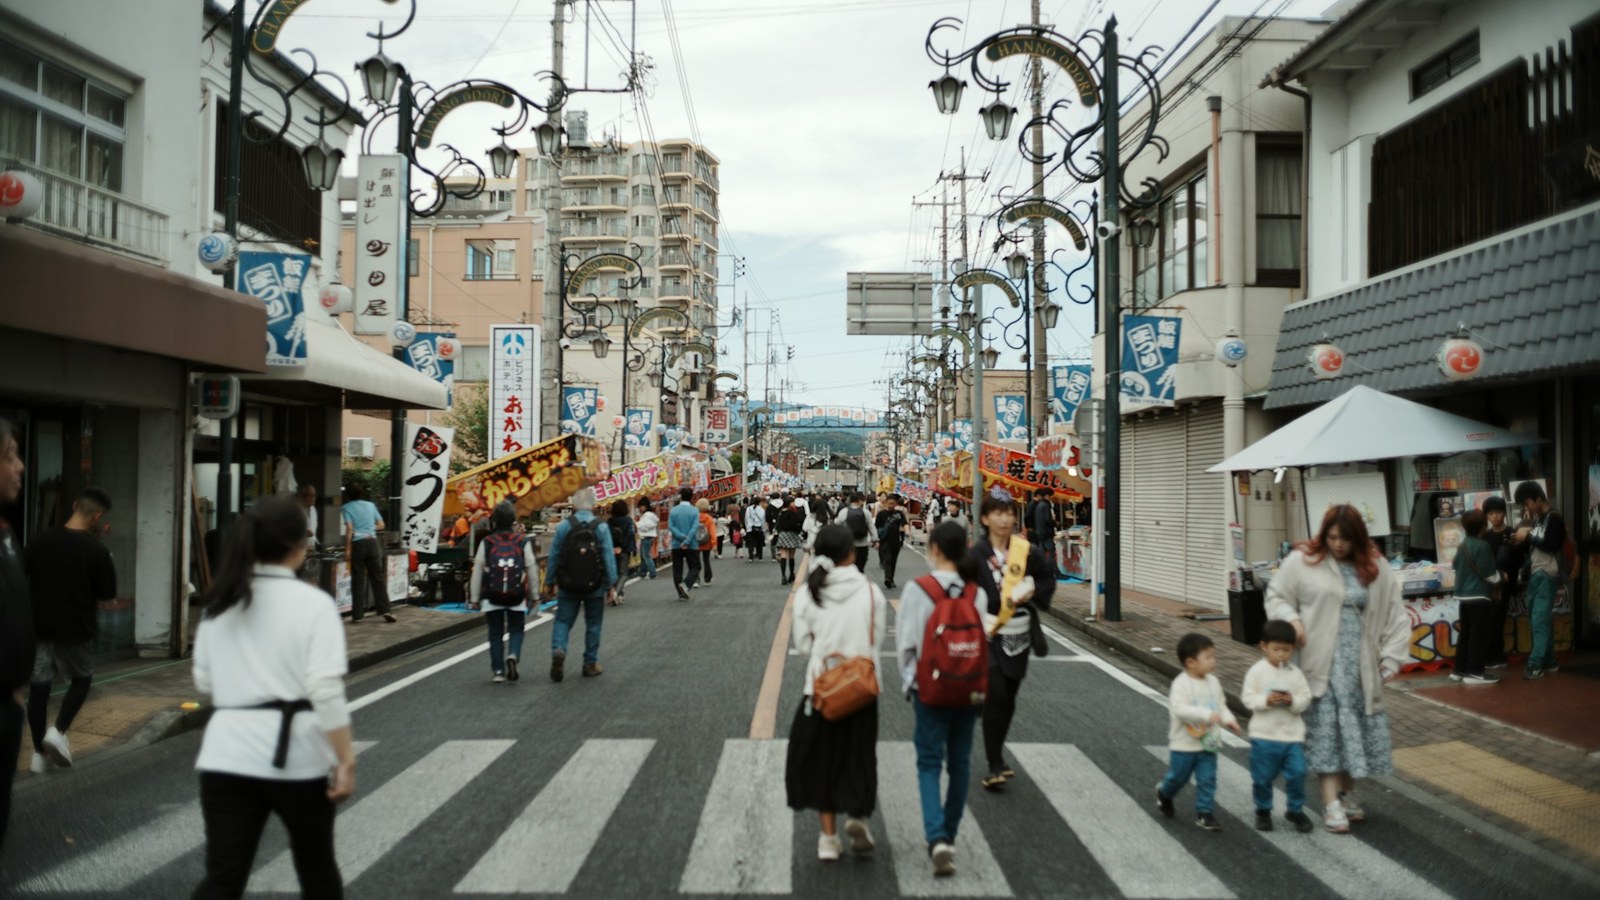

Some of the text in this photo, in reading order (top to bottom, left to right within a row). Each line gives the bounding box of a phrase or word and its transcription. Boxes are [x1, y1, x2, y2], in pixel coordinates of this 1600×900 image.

[998, 40, 1094, 97] HANNO ODORI
[422, 89, 506, 139] HANNO ODORI
[378, 167, 396, 198] 鮮魚
[360, 239, 392, 317] 町田屋
[1132, 328, 1159, 368] まつり
[502, 360, 512, 392] ホテル
[514, 360, 524, 392] ビジネス
[502, 395, 524, 453] おがわ
[706, 432, 714, 440] P
[707, 409, 728, 430] 酒
[482, 447, 571, 510] からあげ
